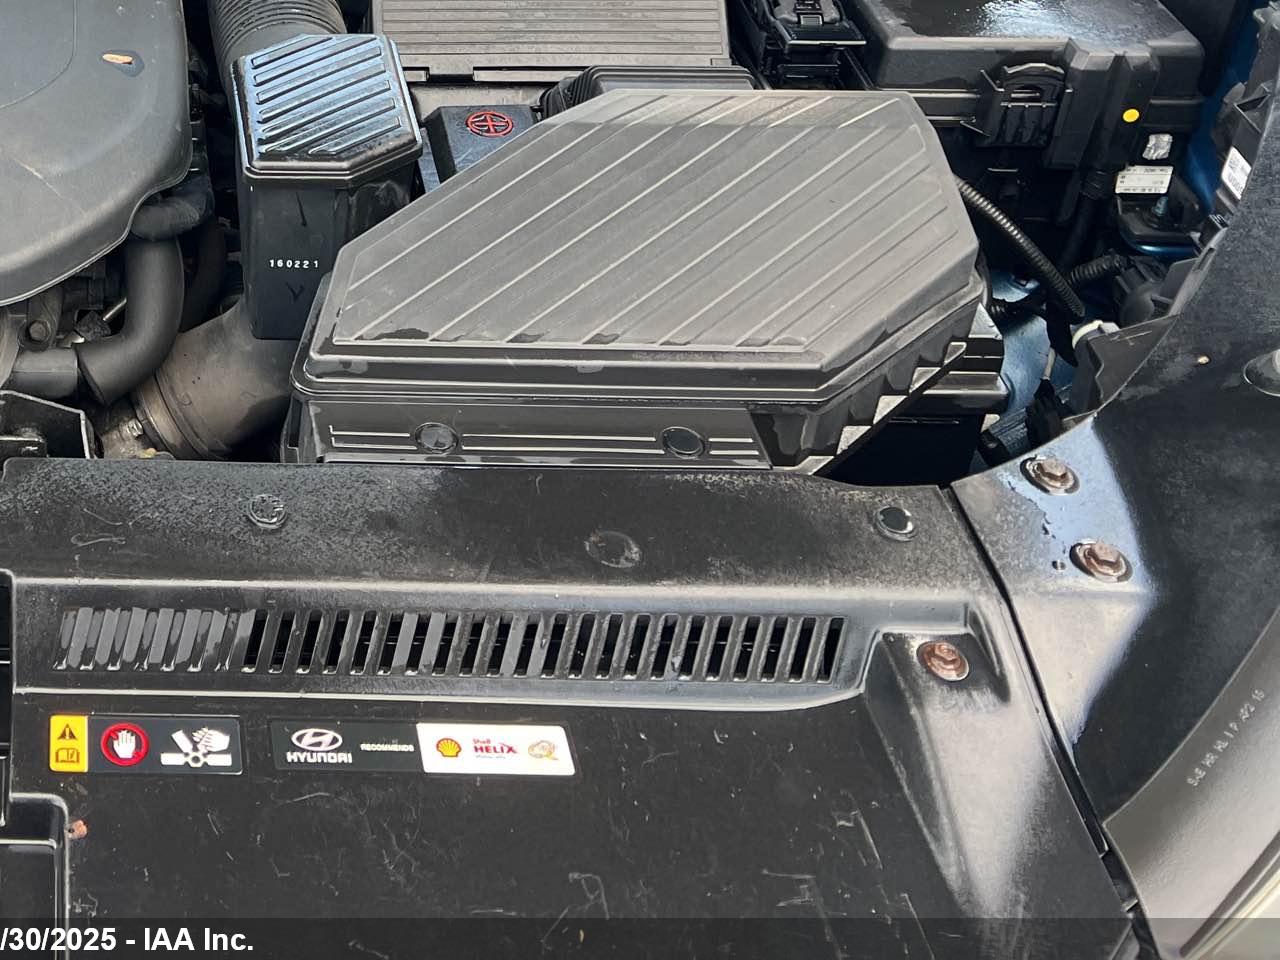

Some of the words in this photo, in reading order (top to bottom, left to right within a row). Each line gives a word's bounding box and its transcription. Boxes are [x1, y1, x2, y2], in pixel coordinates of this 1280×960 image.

[269, 259, 319, 269] 160221
[360, 743, 415, 752] RECOMMENDS
[473, 743, 518, 754] HELIX
[286, 751, 353, 764] HYUNDAI
